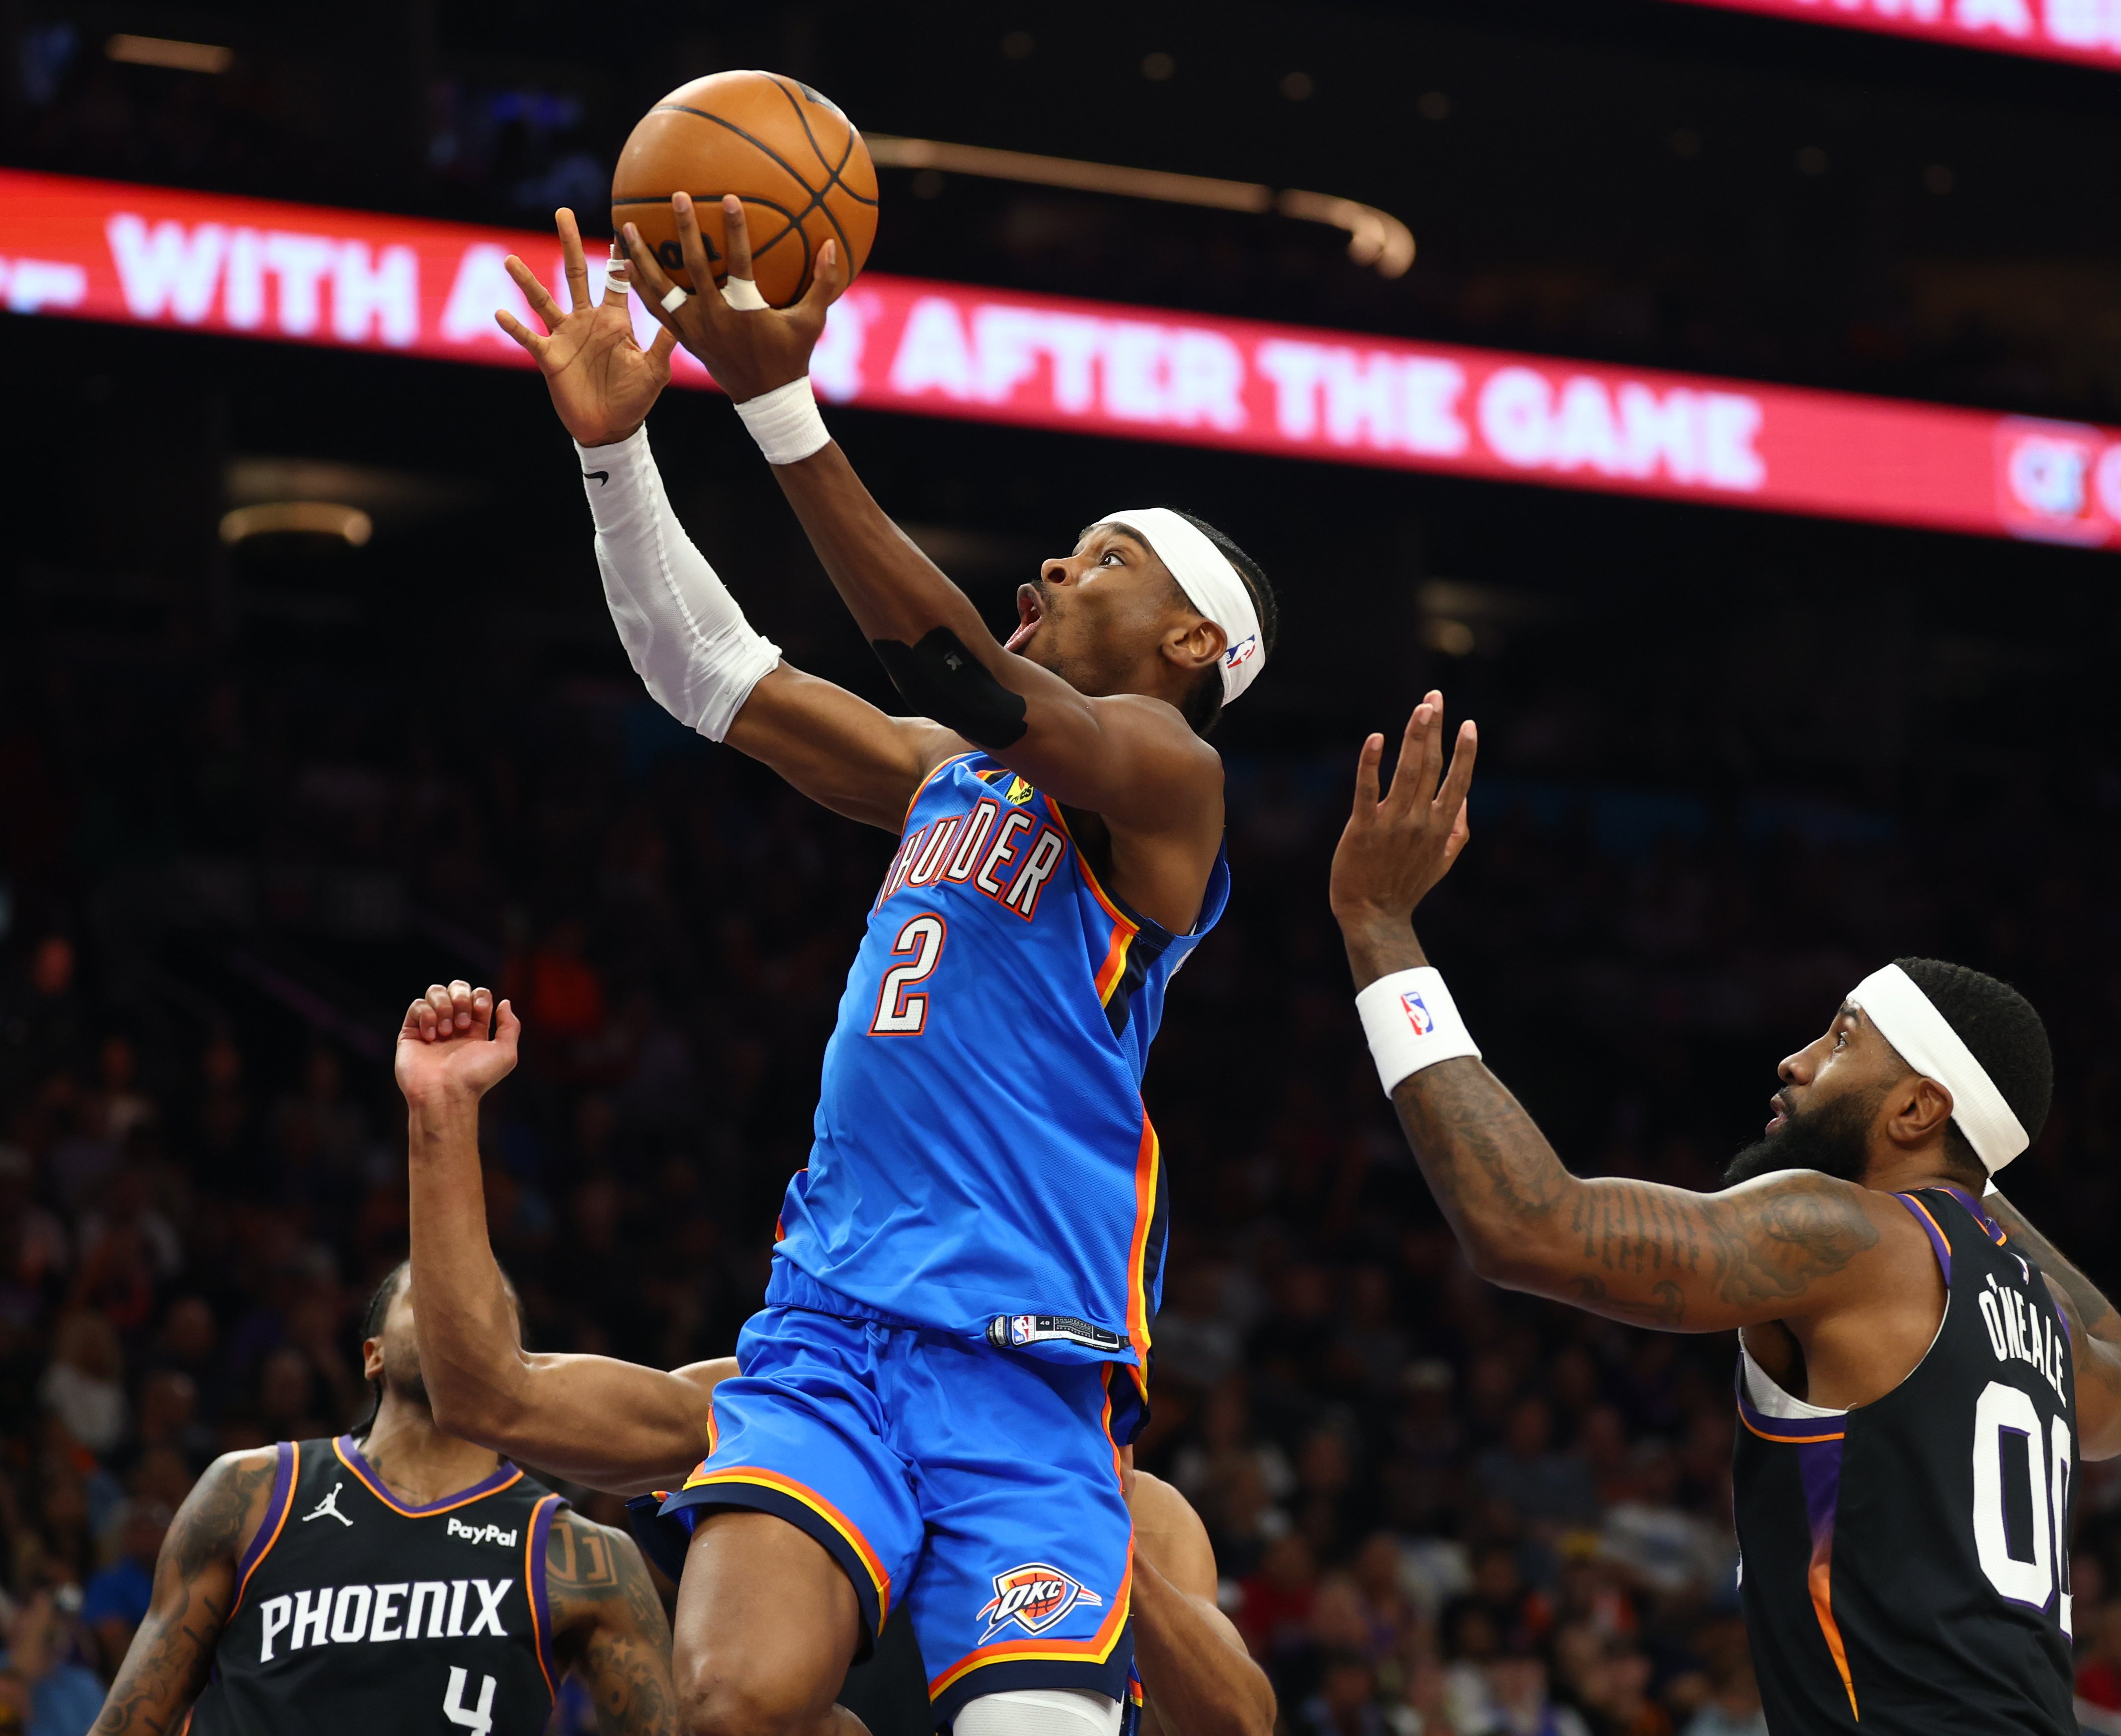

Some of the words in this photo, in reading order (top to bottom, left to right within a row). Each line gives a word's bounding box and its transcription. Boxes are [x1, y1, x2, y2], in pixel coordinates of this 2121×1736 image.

[106, 213, 418, 347] WITH
[891, 297, 1245, 431] AFTER
[1257, 339, 1467, 457] THE
[1478, 367, 1765, 491] GAME
[867, 912, 947, 1037] 2
[1979, 1273, 2066, 1408] O'NEALE
[447, 1518, 517, 1547] PayPal
[259, 1578, 515, 1663] PHOENIX
[993, 1580, 1063, 1621] OKC
[442, 1665, 497, 1736] 4
